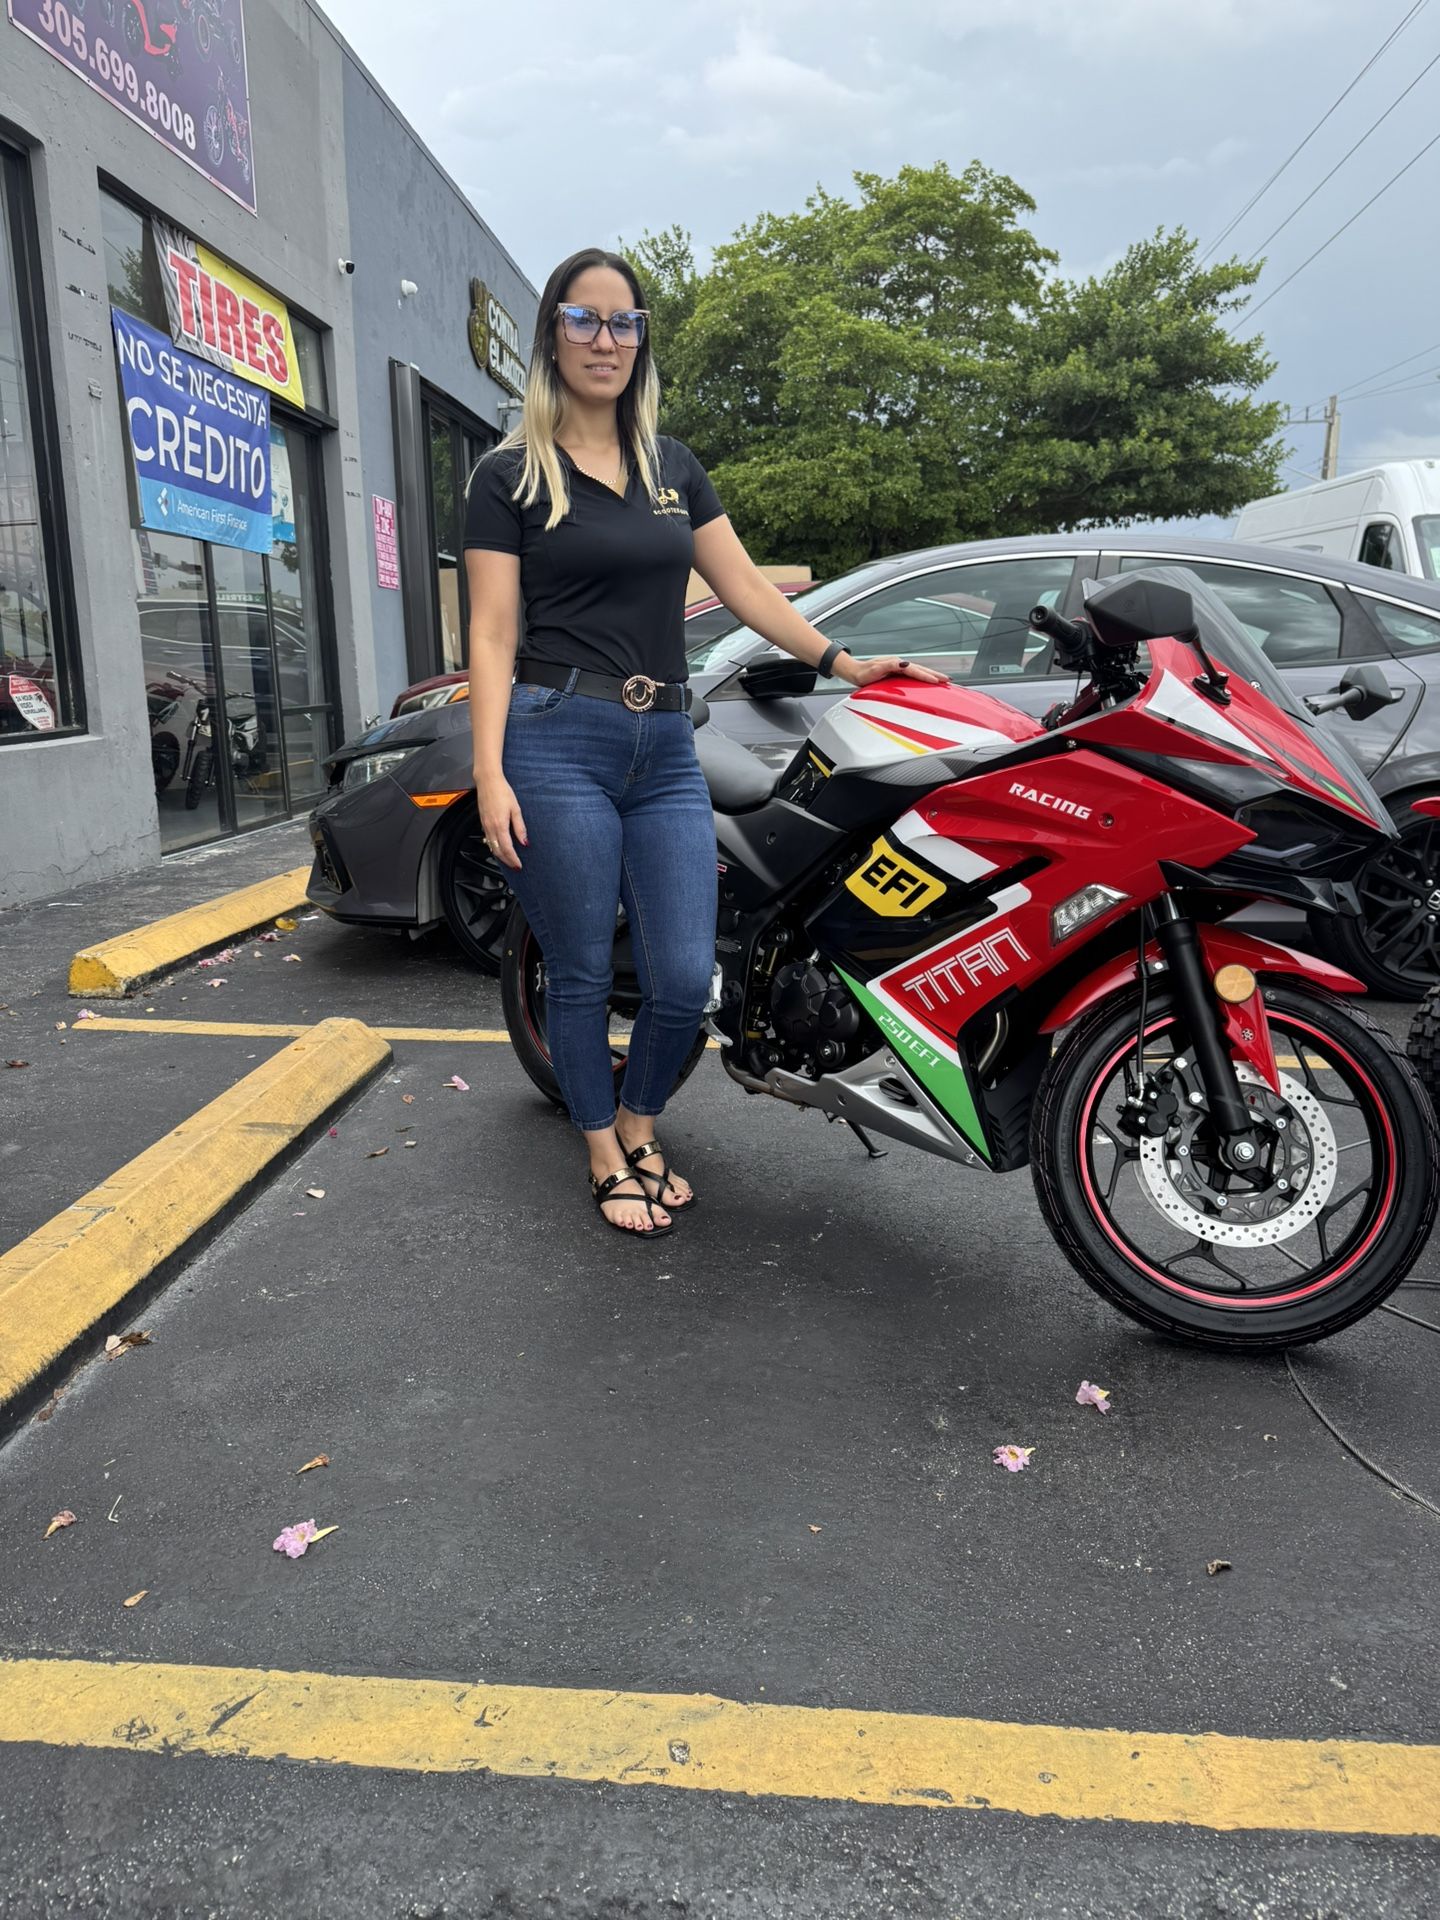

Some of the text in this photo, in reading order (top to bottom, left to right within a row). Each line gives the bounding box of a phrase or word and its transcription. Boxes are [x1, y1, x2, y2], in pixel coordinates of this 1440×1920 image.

[38, 0, 196, 150] 305.699.8008
[168, 245, 290, 387] TIRES
[116, 328, 267, 430] NO SE NECESITA
[127, 397, 266, 500] CRÉDITO
[177, 499, 248, 531] American First Finance
[1009, 782, 1093, 820] RACING
[861, 854, 930, 909] EFI
[902, 927, 1031, 1011] TITAN
